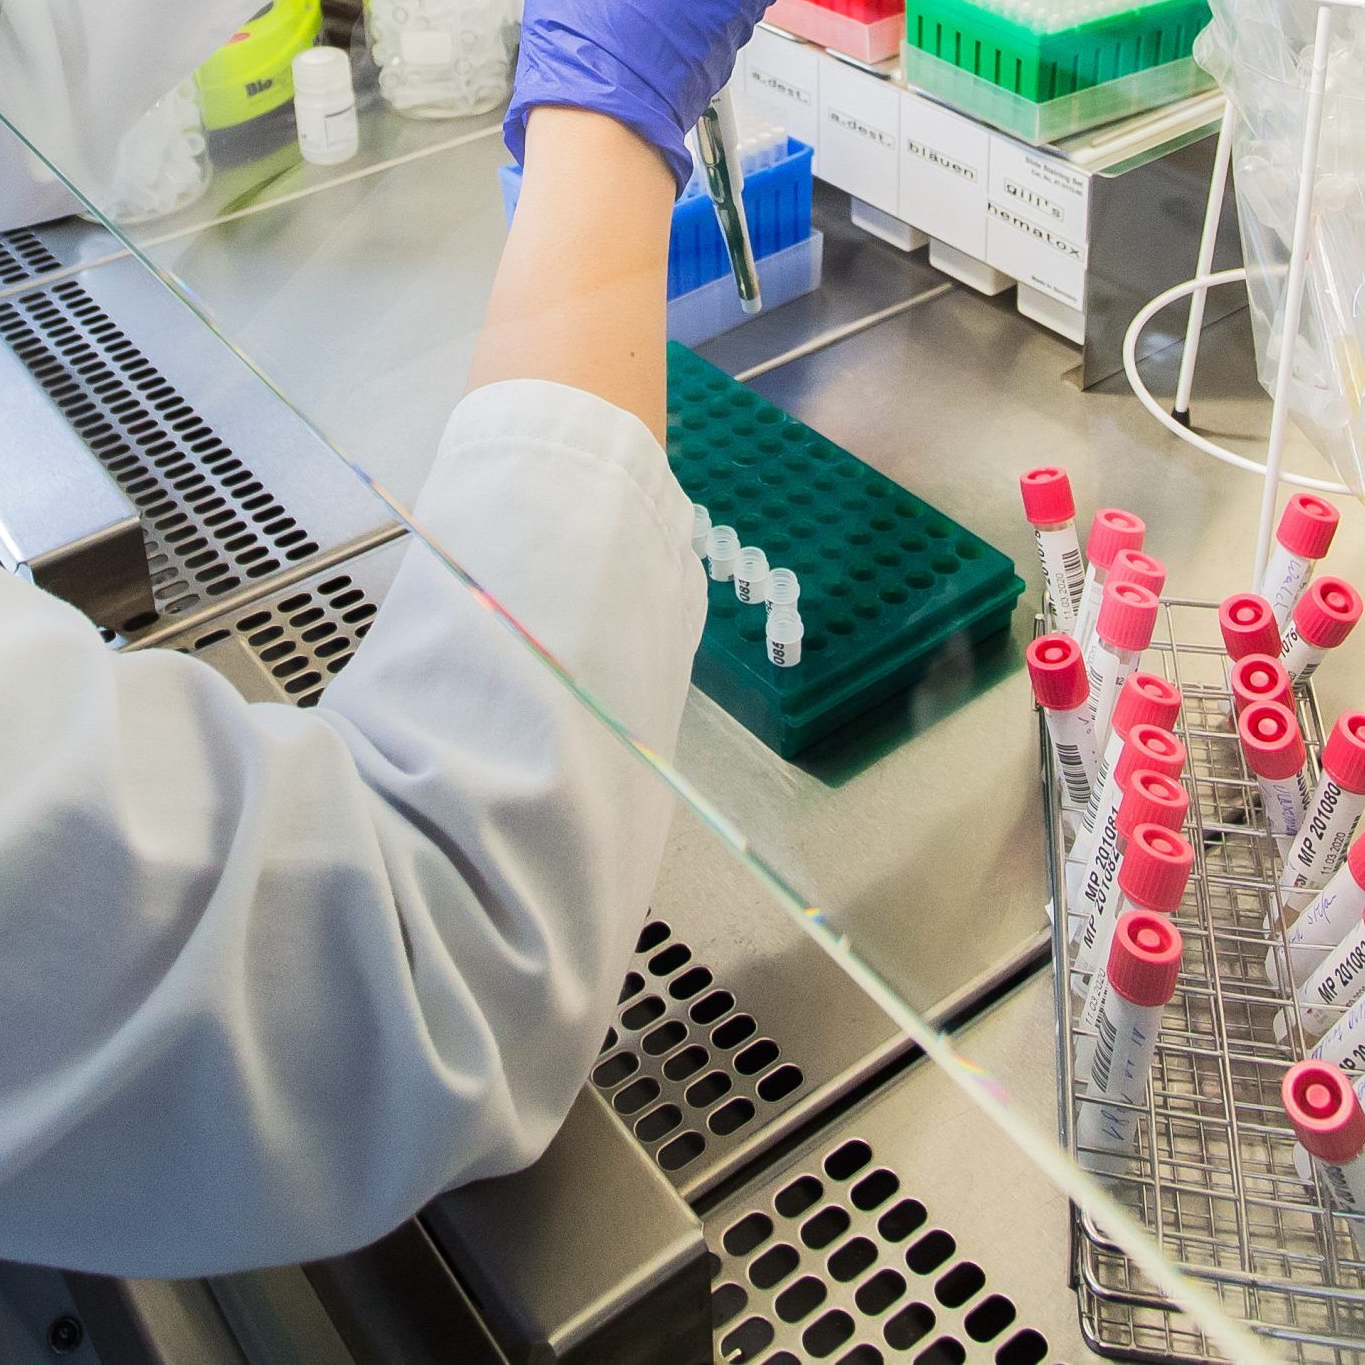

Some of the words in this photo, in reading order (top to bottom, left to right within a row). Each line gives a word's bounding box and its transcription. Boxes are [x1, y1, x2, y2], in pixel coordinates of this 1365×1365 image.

[986, 201, 1080, 258] hematox
[1298, 837, 1316, 868] MP
[1309, 782, 1342, 841] 201080
[1084, 871, 1099, 902] MP
[1095, 806, 1119, 870] 201081
[1320, 832, 1346, 876] 11.03.2020
[1084, 914, 1095, 949] MP
[1085, 968, 1106, 1027] 11.03.2020
[1317, 976, 1338, 1005] MP
